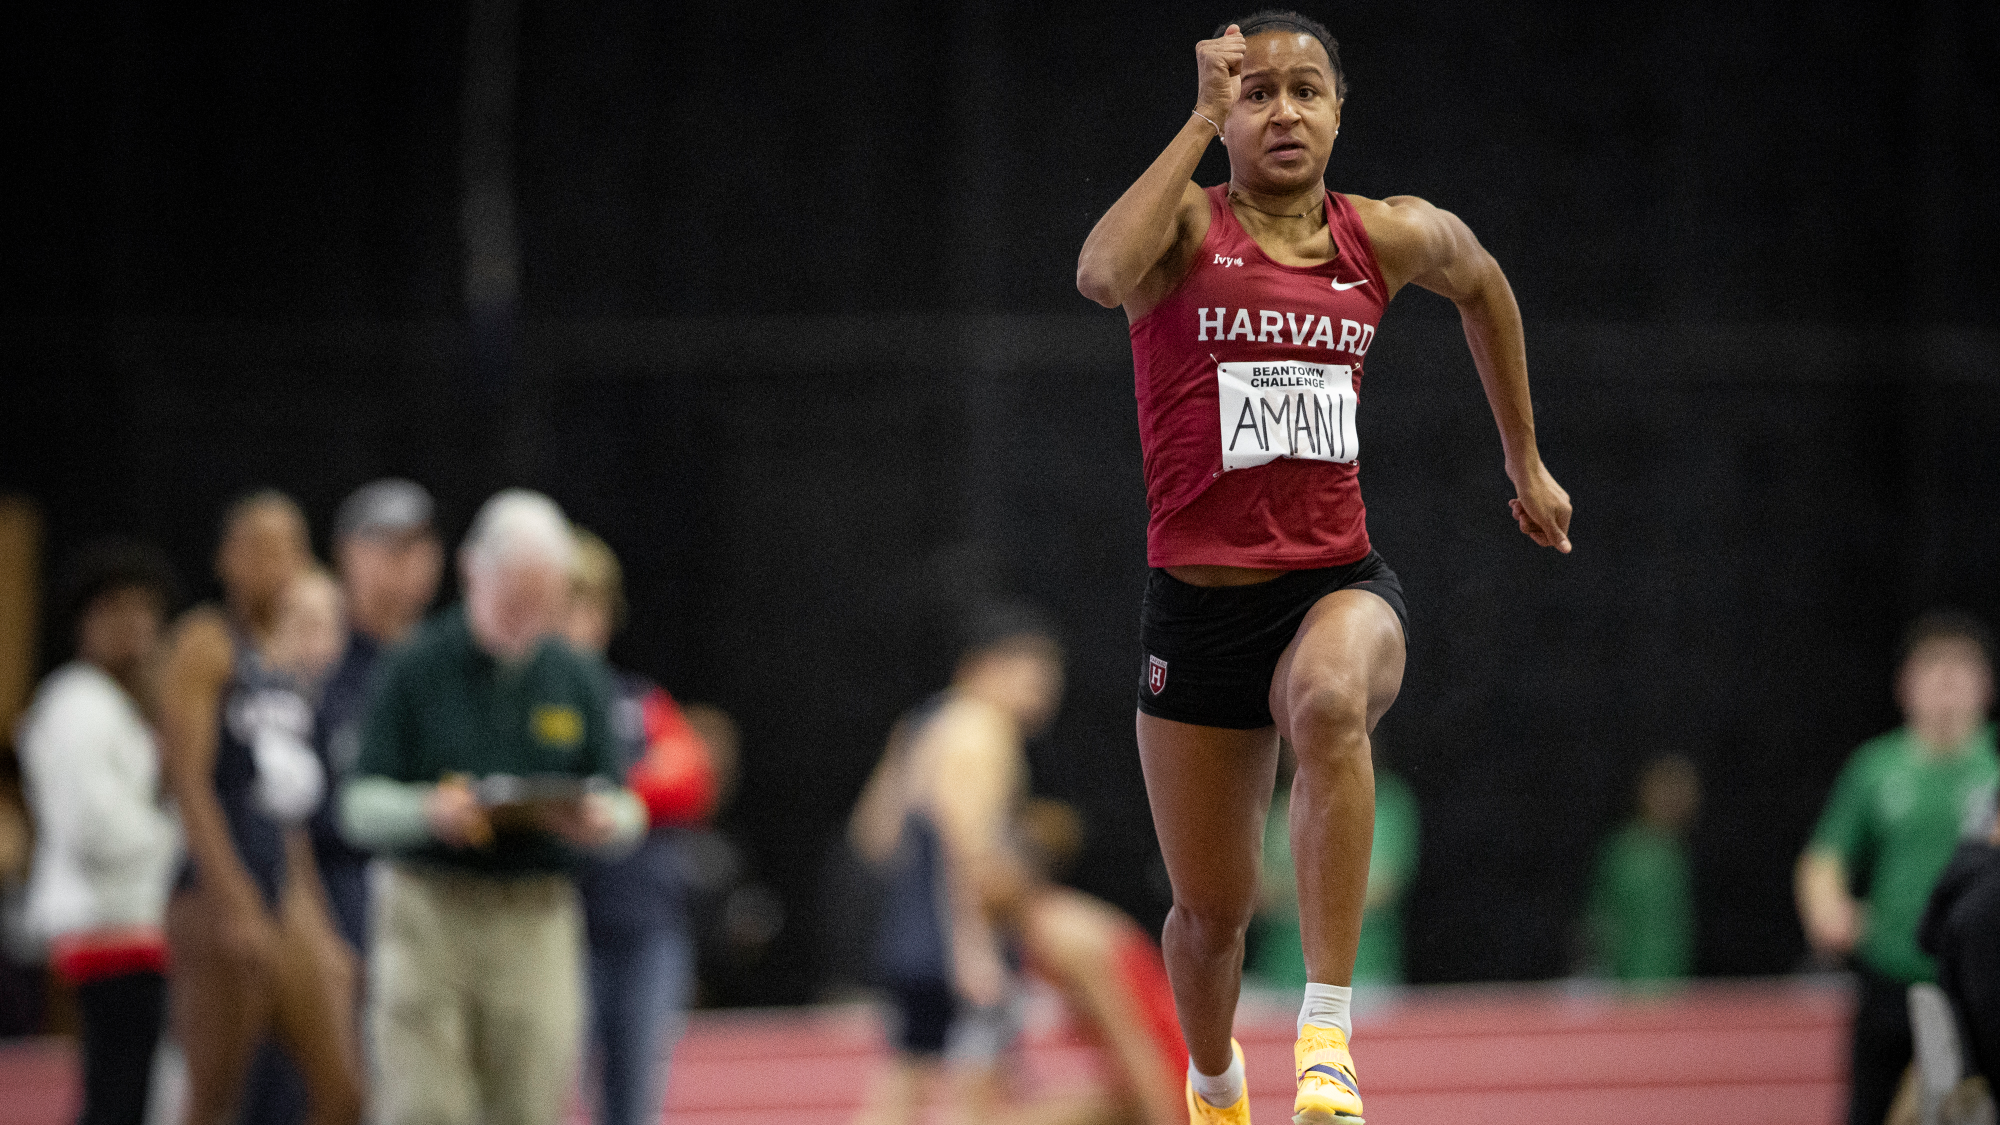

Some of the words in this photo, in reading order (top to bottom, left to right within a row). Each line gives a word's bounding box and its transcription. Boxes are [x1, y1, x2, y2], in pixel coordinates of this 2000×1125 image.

[1213, 253, 1234, 268] Ivy
[1197, 307, 1375, 356] HARVARD
[1252, 366, 1324, 379] BEANTOWN
[1250, 377, 1325, 389] CHALLENGE
[1229, 392, 1346, 459] AMANI
[1151, 665, 1162, 687] H
[1314, 1050, 1345, 1063] NIKE
